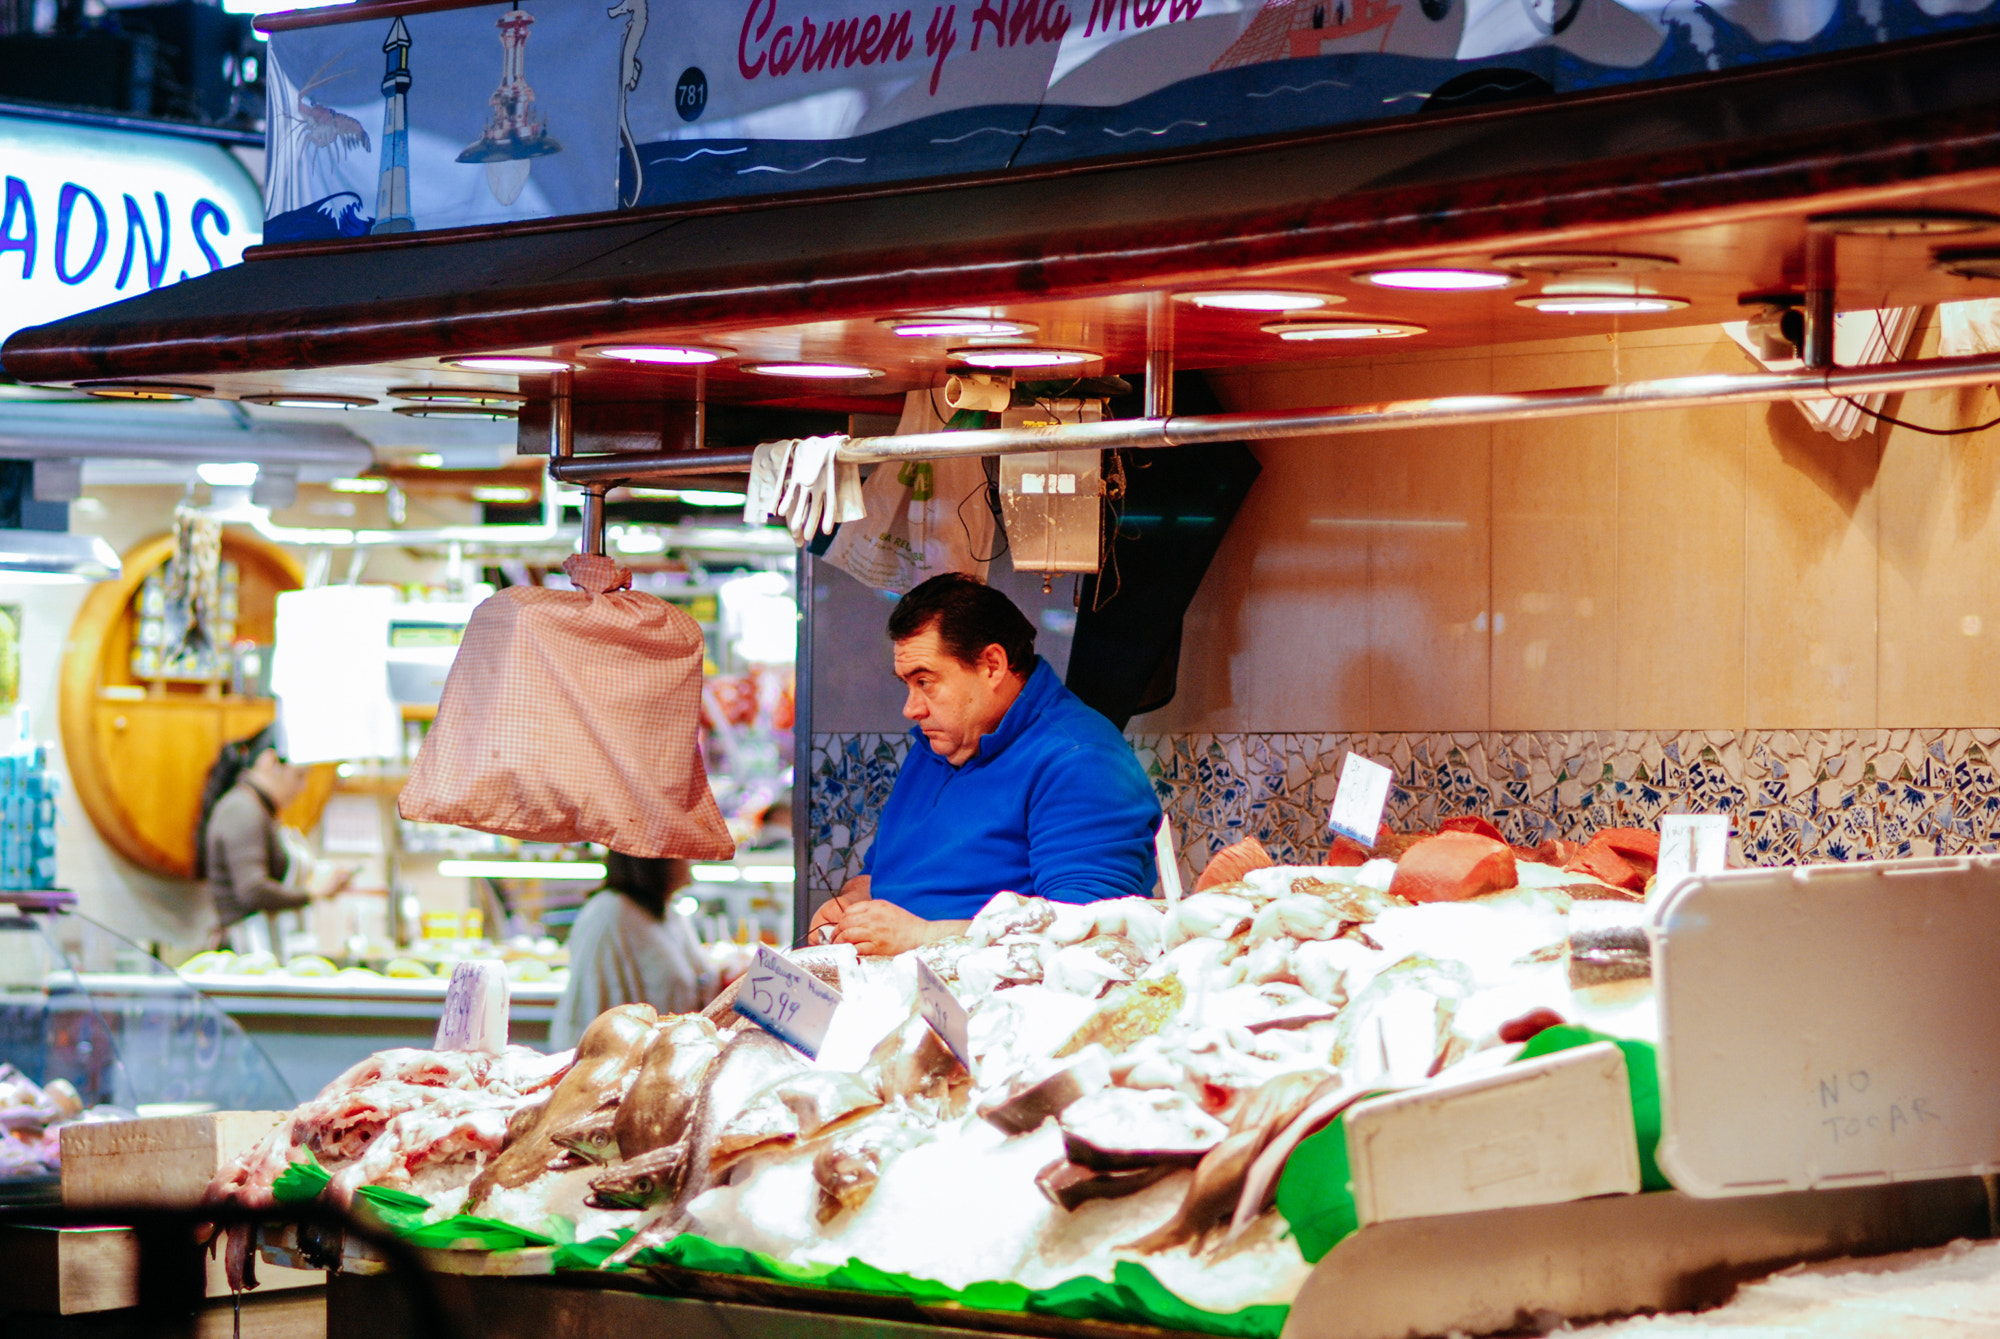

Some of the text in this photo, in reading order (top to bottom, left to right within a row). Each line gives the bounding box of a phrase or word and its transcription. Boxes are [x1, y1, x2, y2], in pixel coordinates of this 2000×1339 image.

[738, 0, 914, 80] Carmen
[925, 4, 957, 96] y
[970, 0, 1072, 52] Ana
[678, 84, 704, 106] 781
[1819, 1069, 1870, 1109] NO
